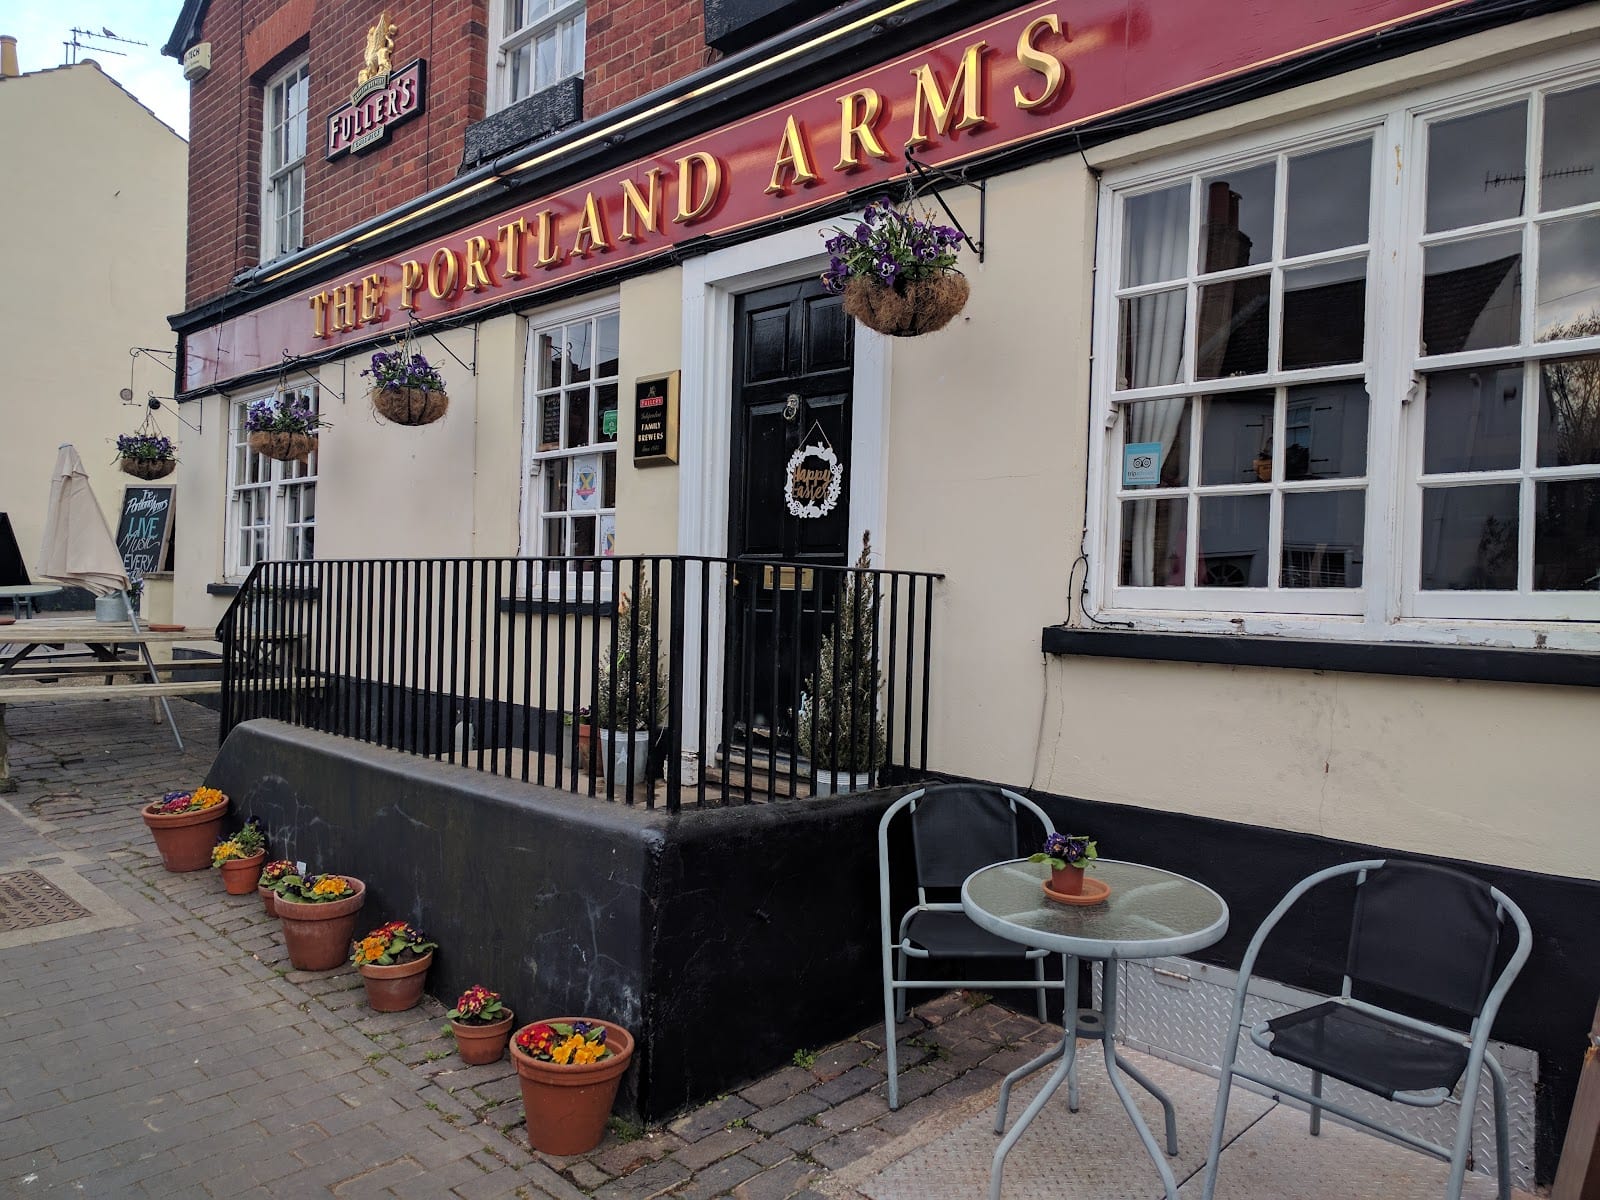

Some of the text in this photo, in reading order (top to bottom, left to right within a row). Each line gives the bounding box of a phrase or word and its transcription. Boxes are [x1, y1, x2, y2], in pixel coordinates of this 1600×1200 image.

[331, 78, 412, 149] FULLER'S
[308, 13, 1067, 340] THE PORTLAND ARMS
[638, 432, 664, 442] BREWERS
[641, 422, 661, 431] FAMILY
[793, 464, 834, 487] Happy
[128, 517, 160, 539] LIVE
[124, 554, 154, 570] EVERY
